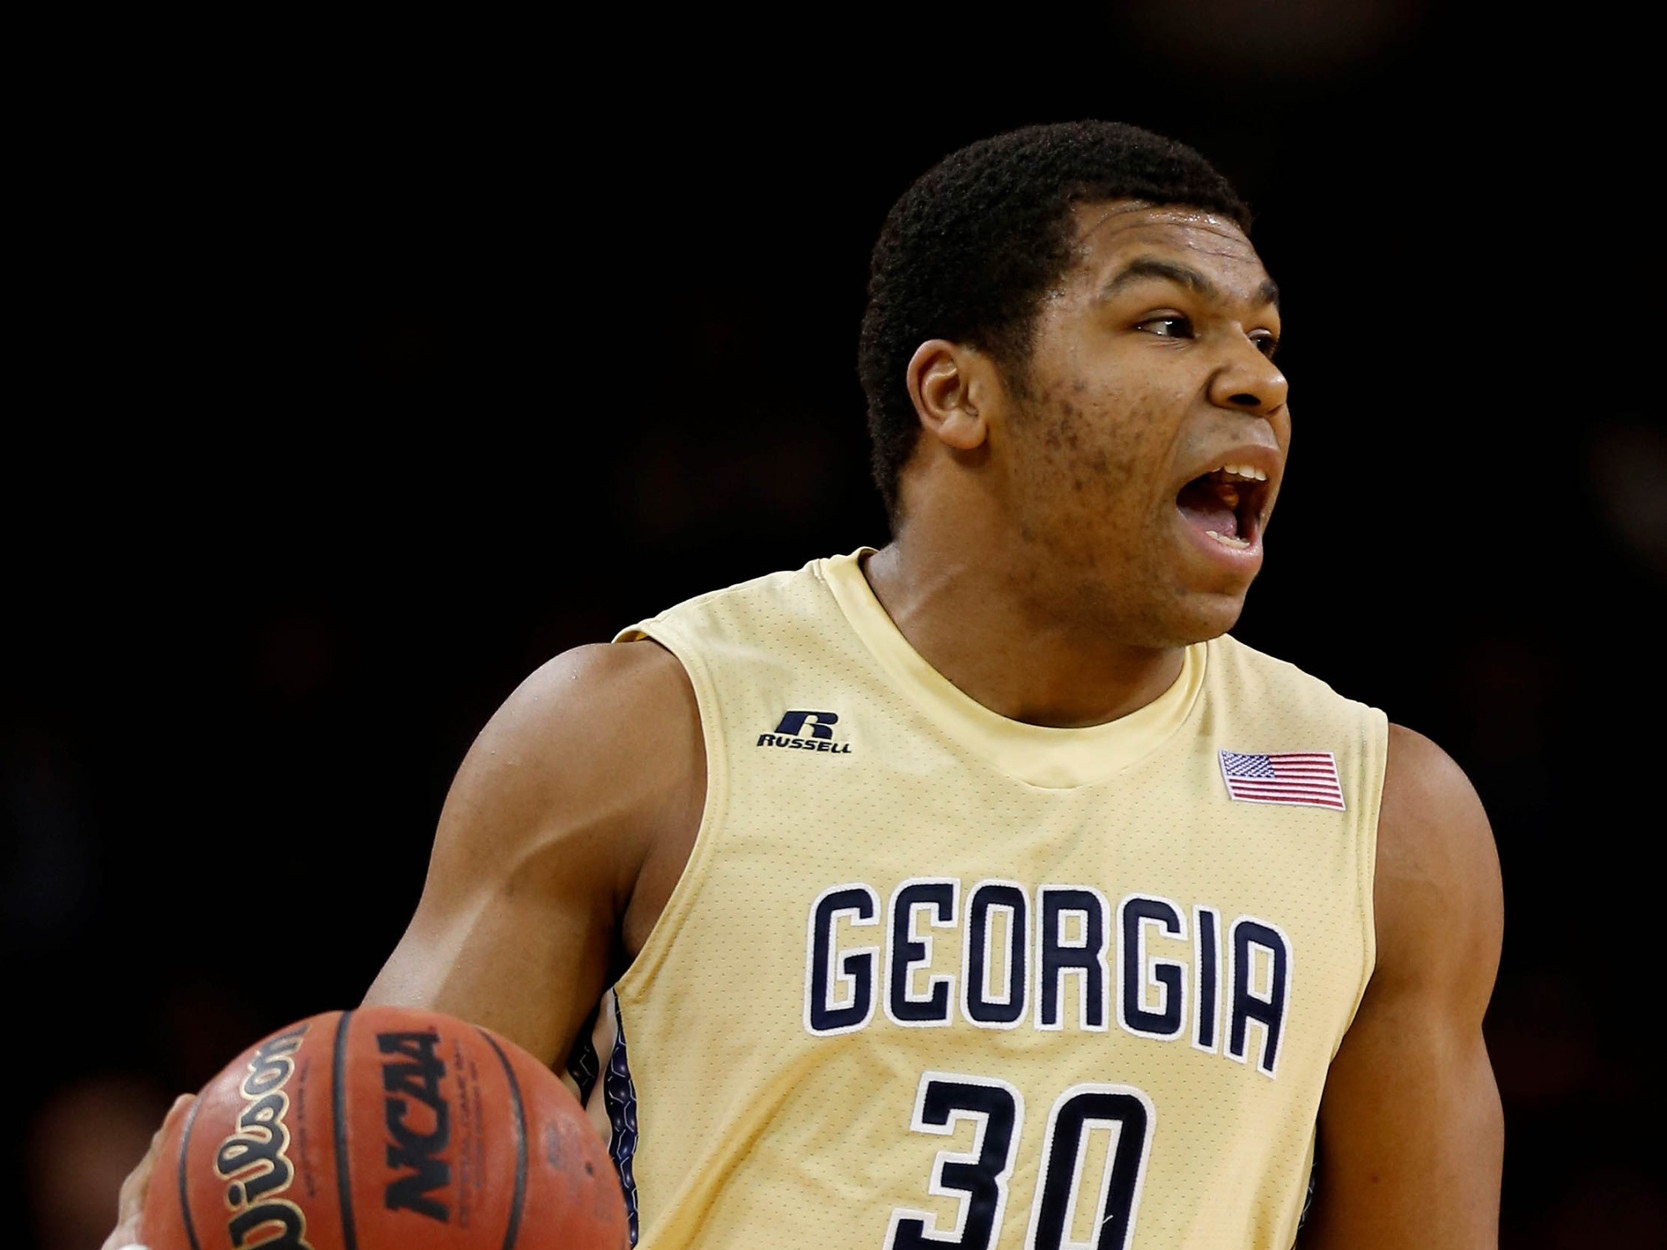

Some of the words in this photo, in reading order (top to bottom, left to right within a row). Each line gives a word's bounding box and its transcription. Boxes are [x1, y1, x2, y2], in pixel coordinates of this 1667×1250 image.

[756, 733, 852, 754] RUSSELL
[803, 876, 1294, 1079] GEORGIA
[376, 1031, 451, 1224] NCAA
